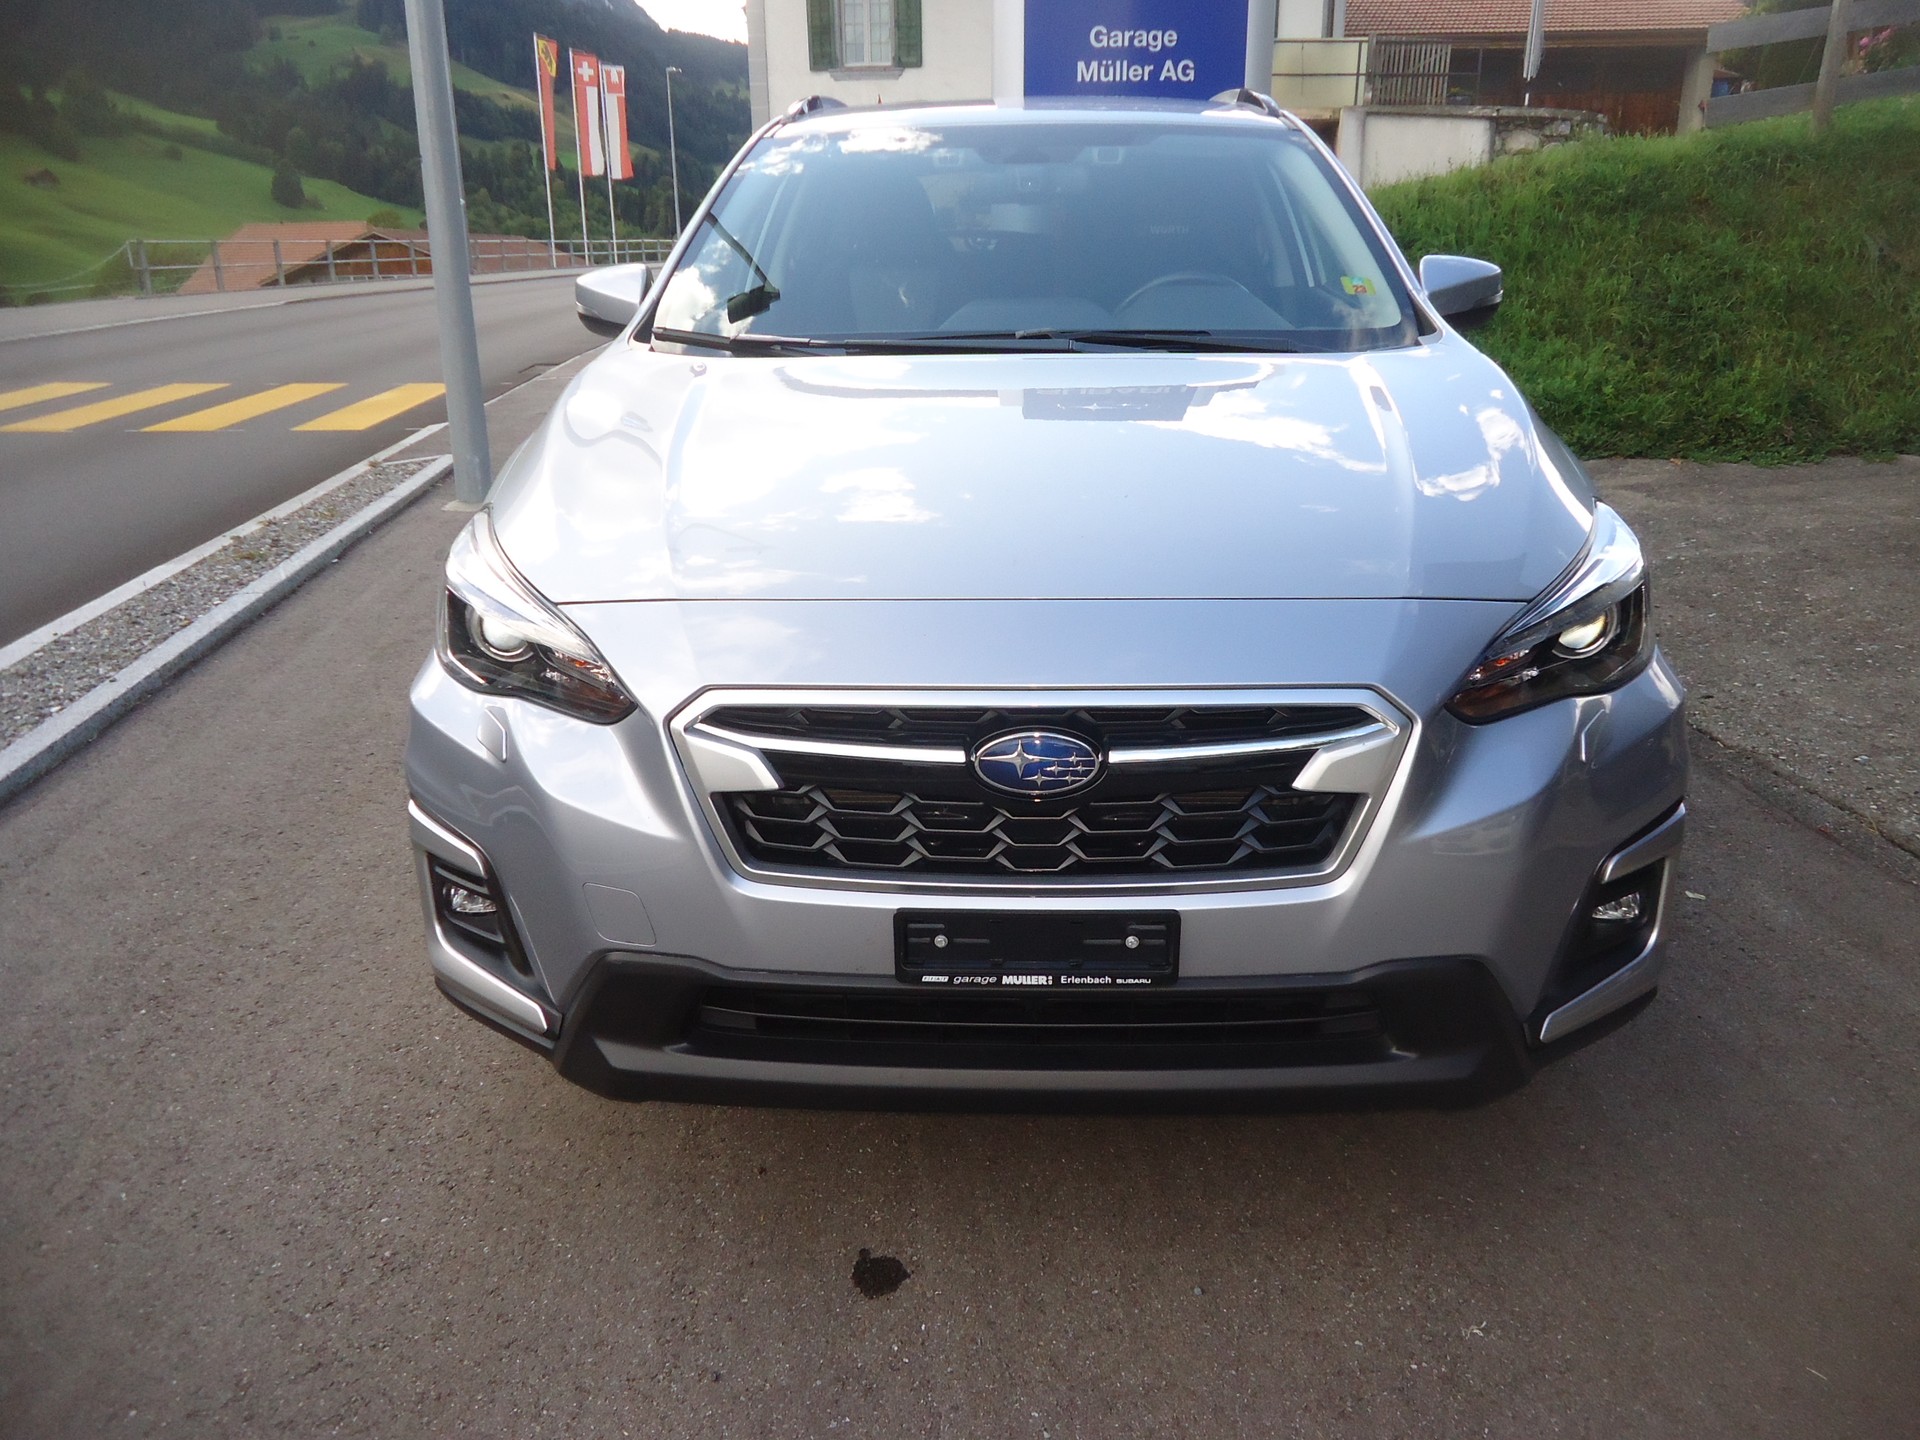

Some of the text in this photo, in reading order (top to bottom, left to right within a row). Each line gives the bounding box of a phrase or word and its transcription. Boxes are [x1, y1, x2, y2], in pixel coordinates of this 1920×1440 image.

[1089, 25, 1178, 52] Garage
[1076, 59, 1195, 82] Müller AG
[953, 976, 998, 985] garage
[1060, 975, 1112, 984] Erlenbach
